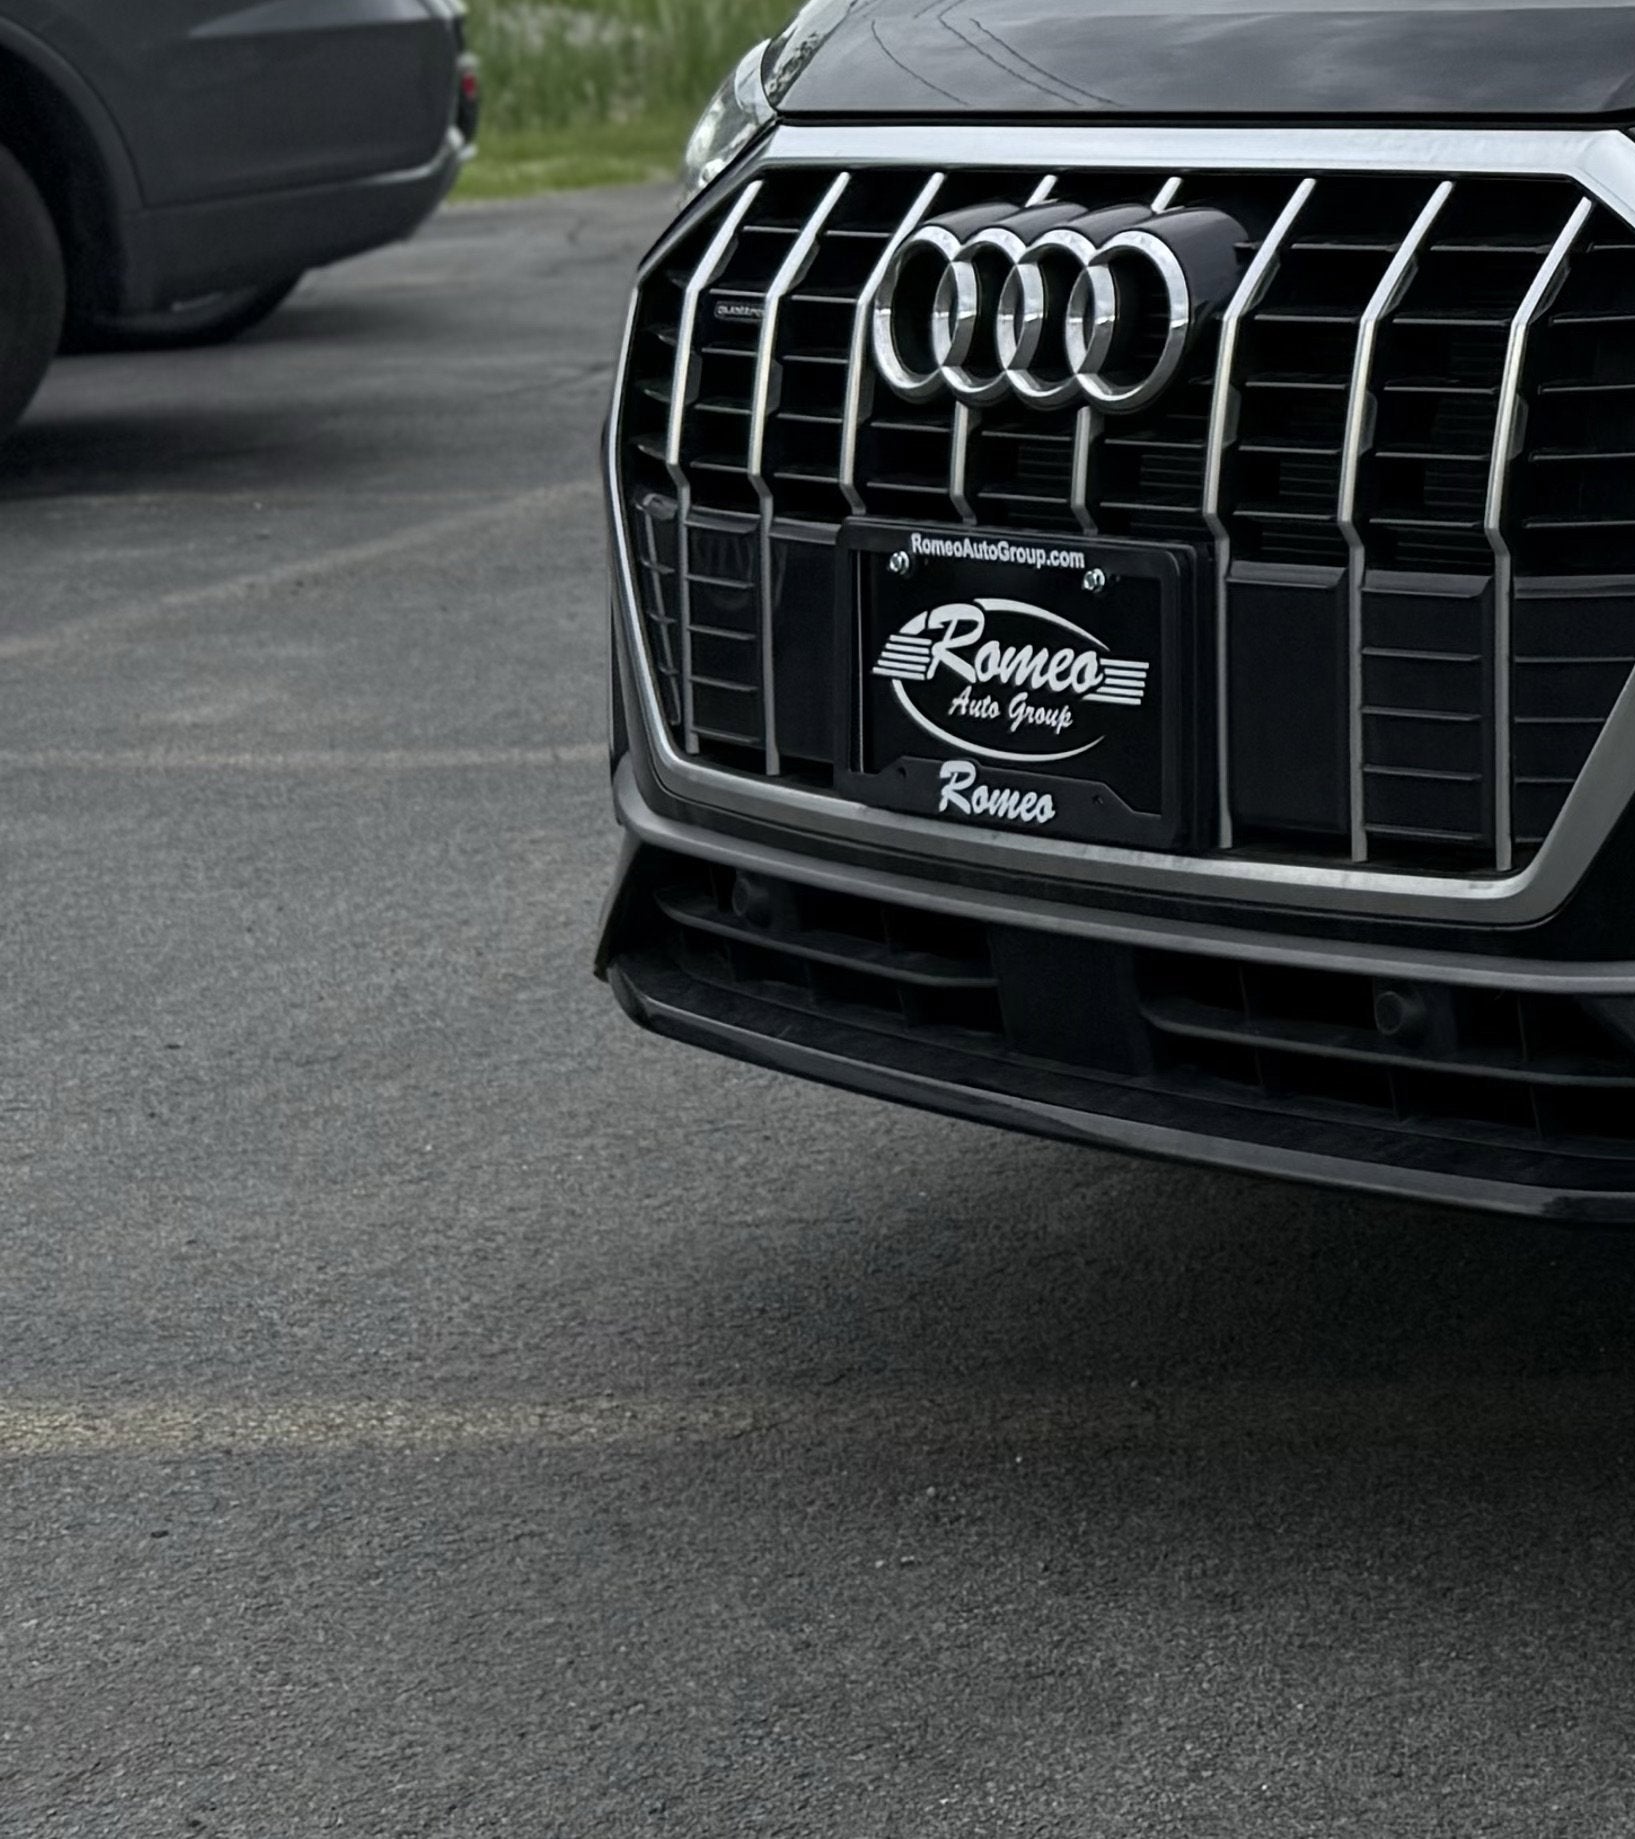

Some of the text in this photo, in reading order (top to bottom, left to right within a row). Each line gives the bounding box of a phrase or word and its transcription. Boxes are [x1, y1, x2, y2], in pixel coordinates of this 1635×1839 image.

[911, 533, 1086, 569] RomeoAutoGroup.com
[926, 603, 1103, 692] Romeo
[949, 685, 1073, 734] Auto Group
[939, 760, 1056, 823] Romeo
